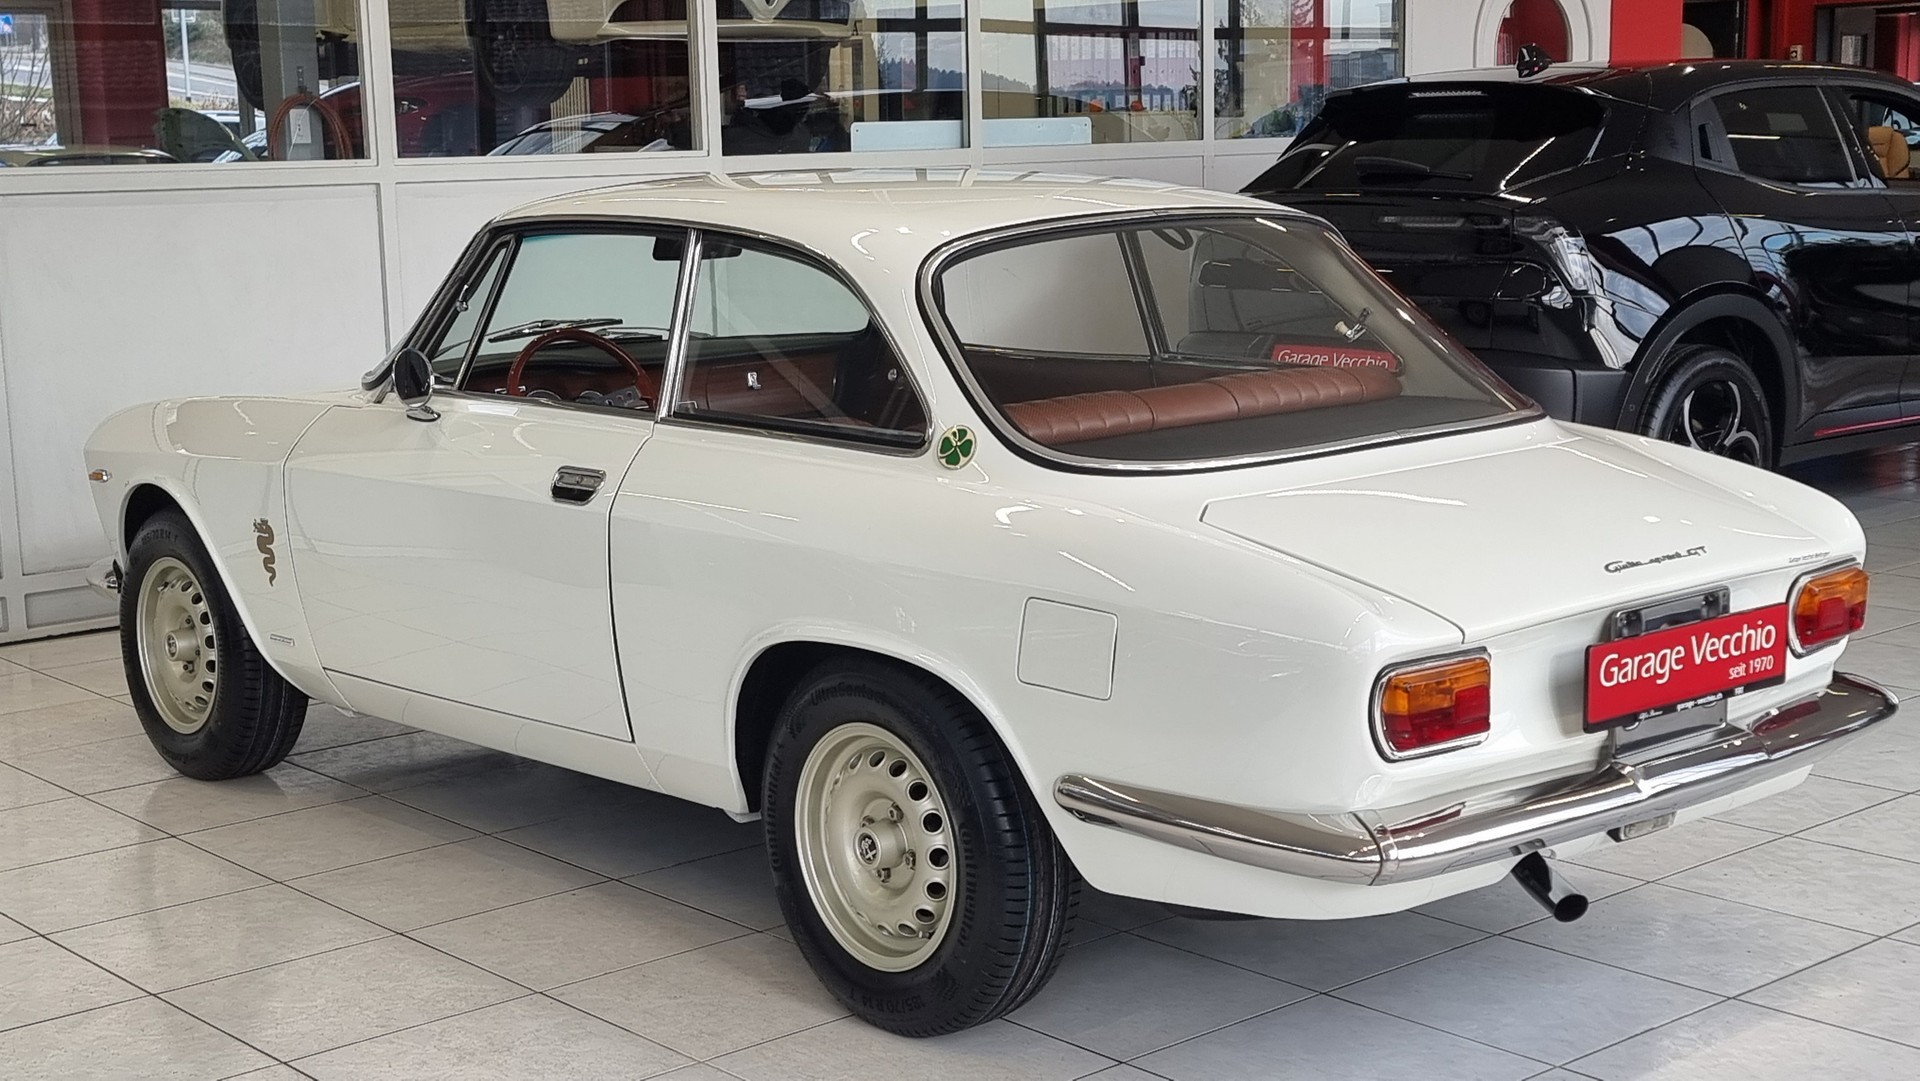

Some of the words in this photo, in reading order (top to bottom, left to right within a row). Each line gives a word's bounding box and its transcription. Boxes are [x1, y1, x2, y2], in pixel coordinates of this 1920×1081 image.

[1278, 350, 1329, 366] Garage
[1333, 352, 1389, 368] Vecchio
[1599, 645, 1685, 687] Garage
[1690, 620, 1776, 666] Vecchio
[1728, 661, 1746, 680] seit
[1749, 655, 1775, 674] 1970
